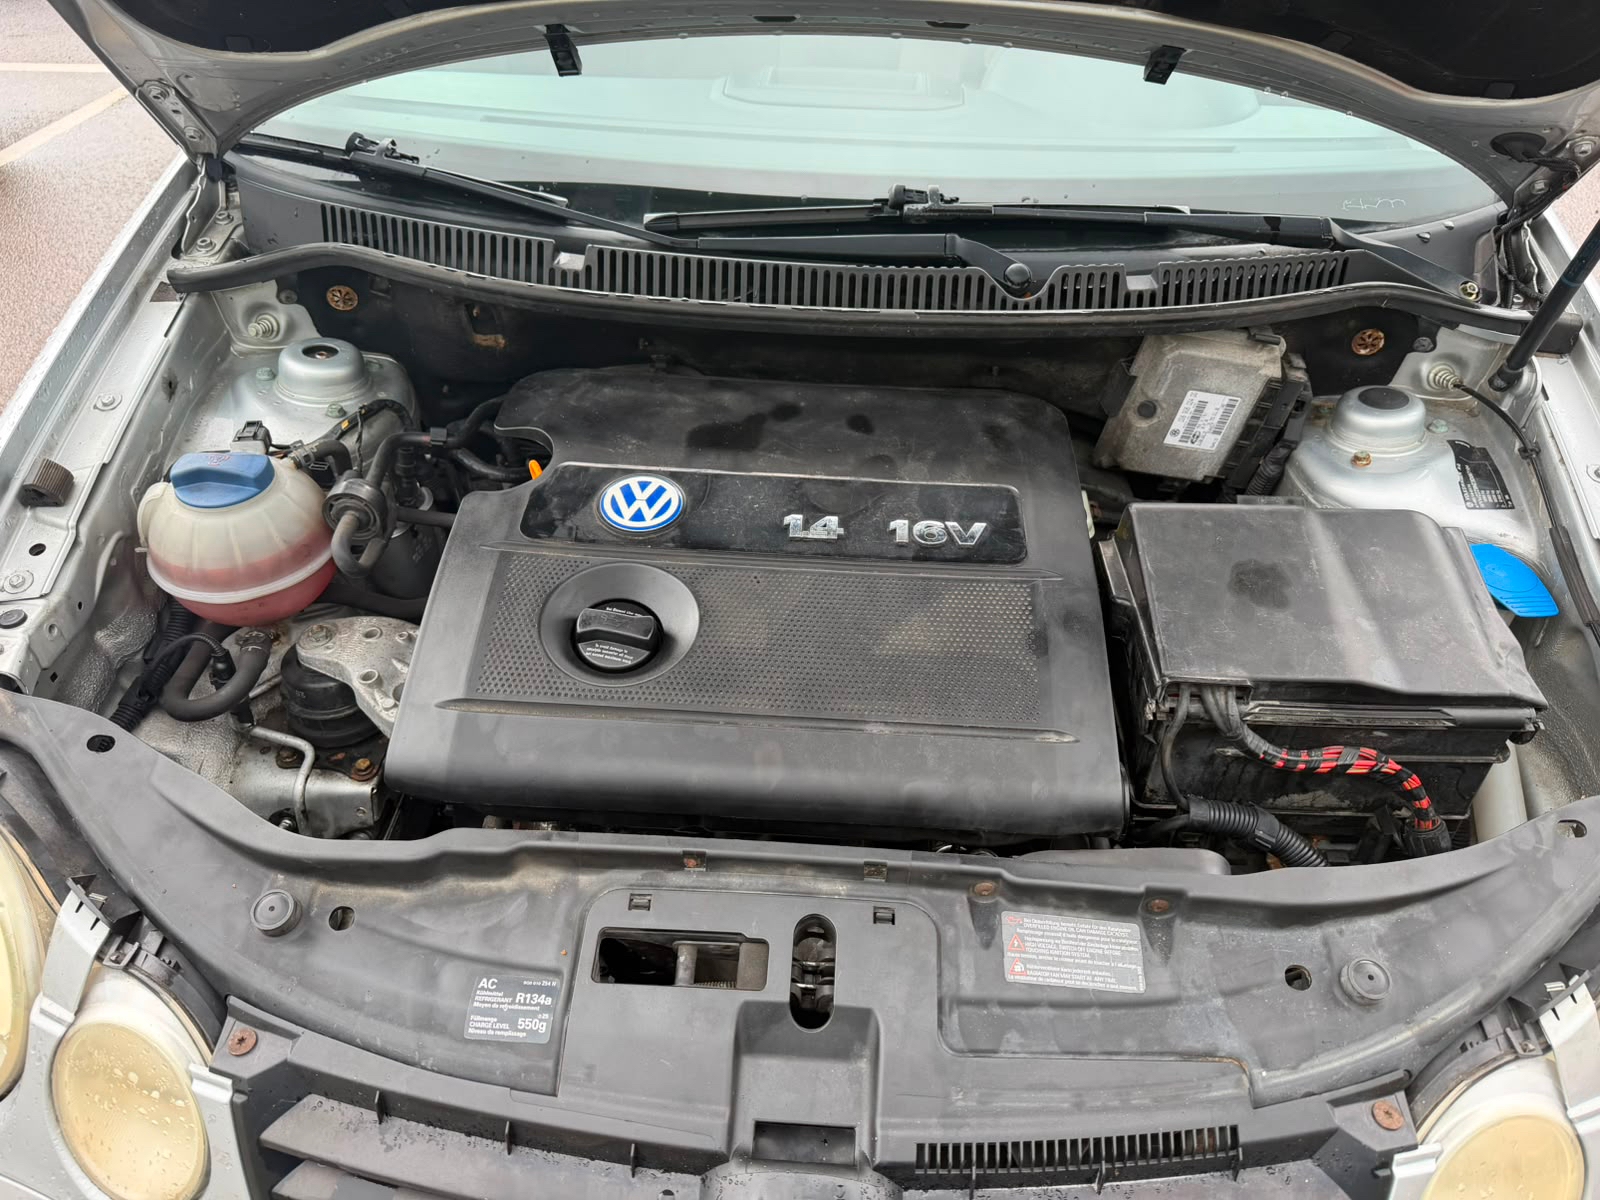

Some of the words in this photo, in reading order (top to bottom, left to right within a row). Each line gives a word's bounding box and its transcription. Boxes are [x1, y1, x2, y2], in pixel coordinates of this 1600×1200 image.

[784, 514, 844, 540] 1.4
[889, 519, 987, 546] 16V
[478, 978, 497, 989] AC
[516, 992, 552, 1005] R134a
[518, 1018, 546, 1033] 550g
